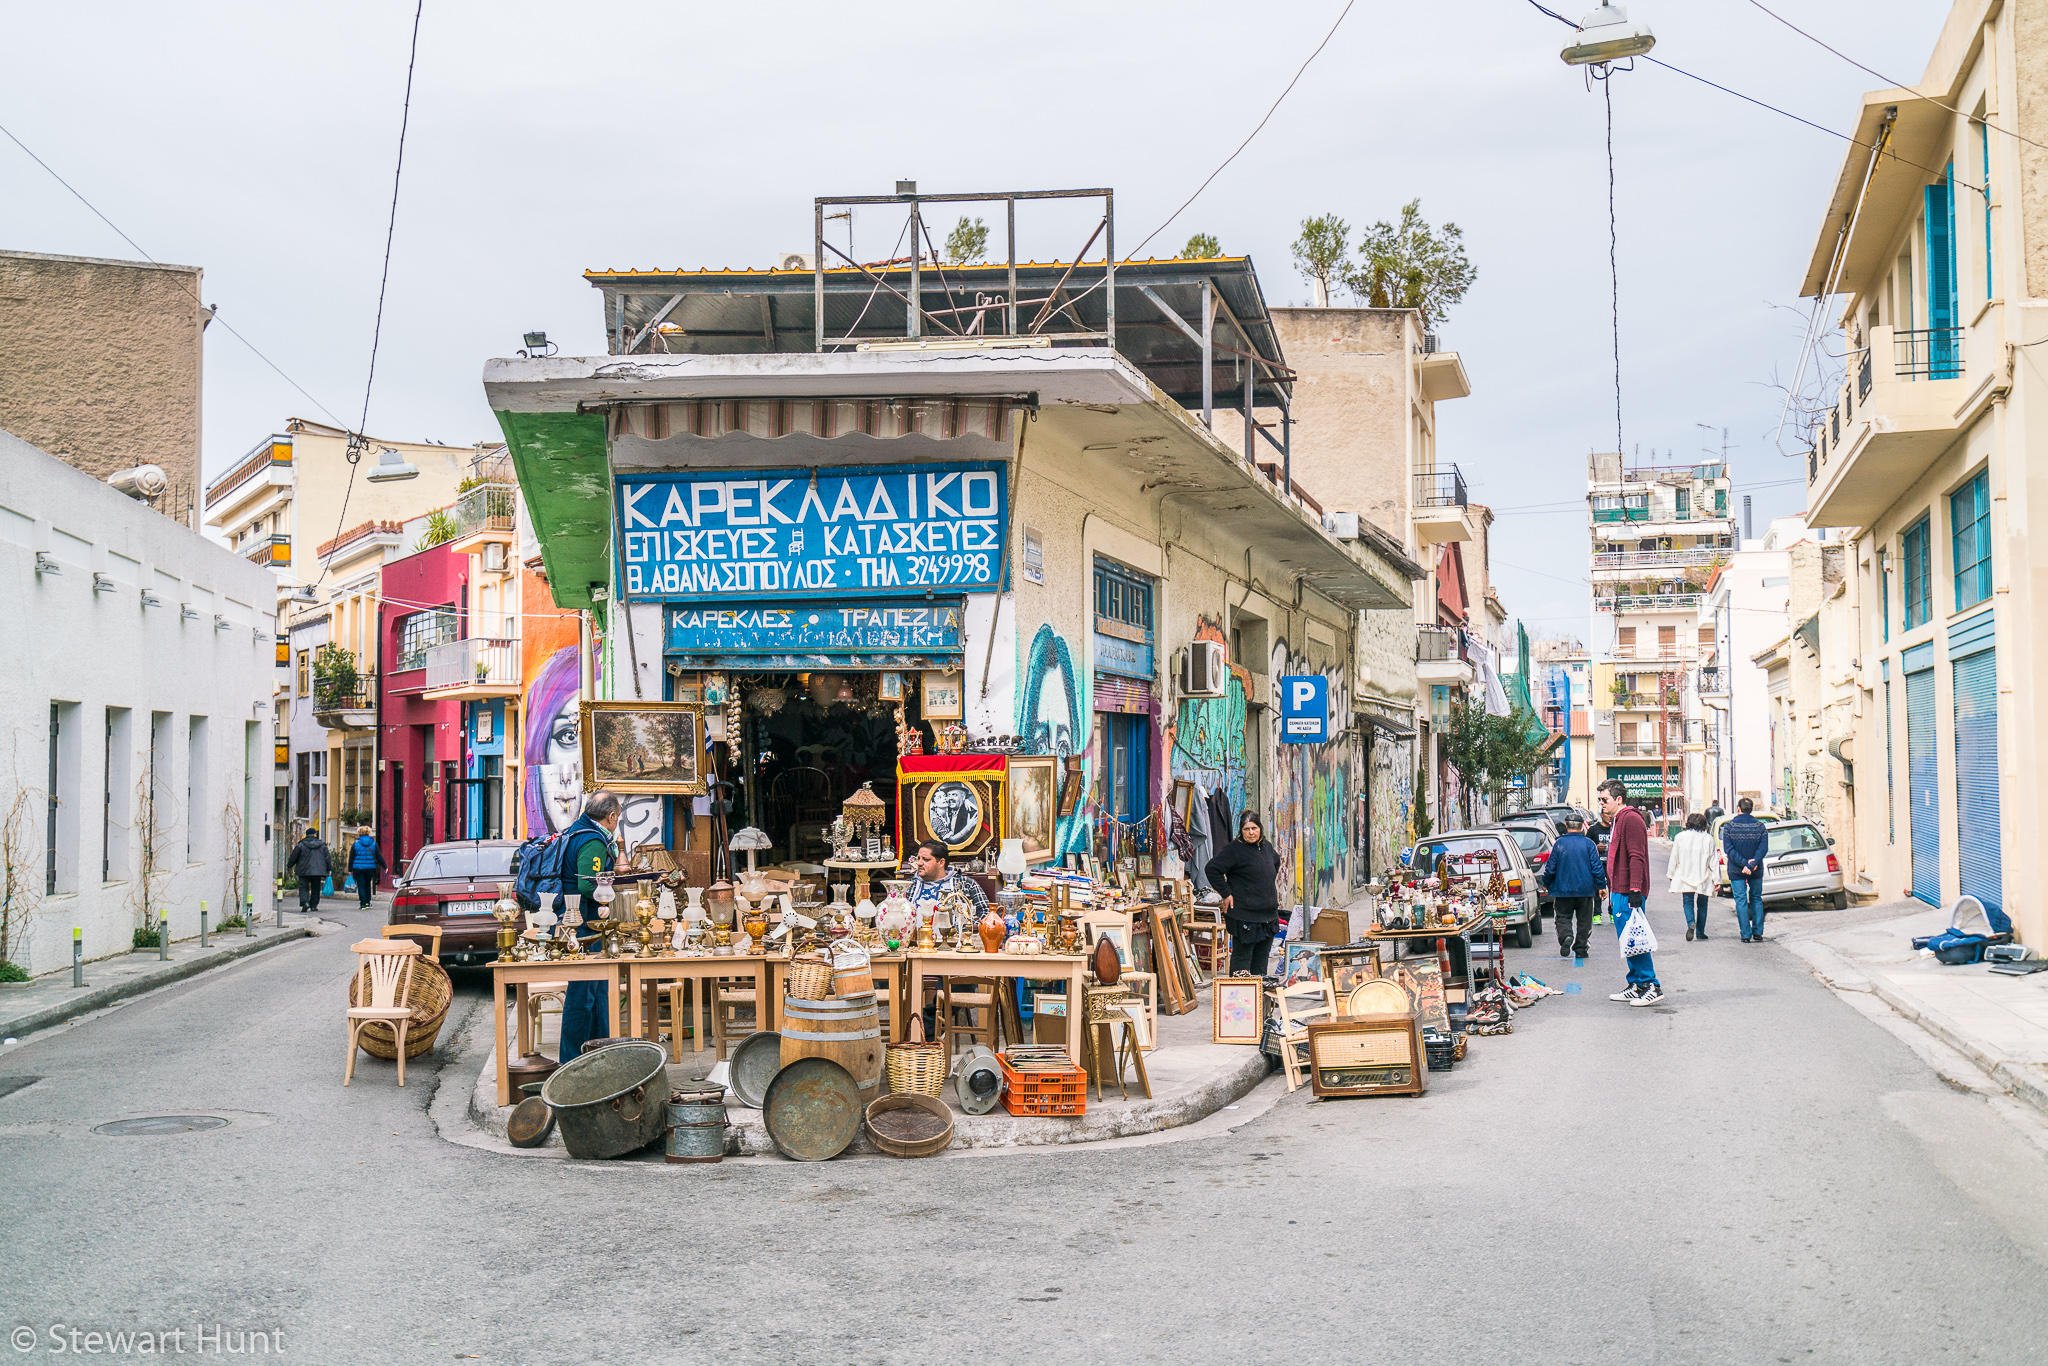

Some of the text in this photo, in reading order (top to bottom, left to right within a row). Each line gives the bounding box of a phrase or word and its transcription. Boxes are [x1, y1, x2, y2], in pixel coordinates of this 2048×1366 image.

[622, 471, 999, 529] ΚΑΡΕΚΛΑΔΙΚΟ
[625, 519, 999, 563] ΕΠΙΣΚΕΥΕΣ ΚΑΤΑΣΚΕΥΕΣ
[857, 557, 901, 587] ΤΗΛ
[906, 553, 990, 585] 3249998
[672, 608, 957, 628] ΚΑΡΕΚΛΕΣ ΤΡΑΠΕΖΙΑ
[1293, 681, 1316, 711] P
[592, 856, 601, 872] 3
